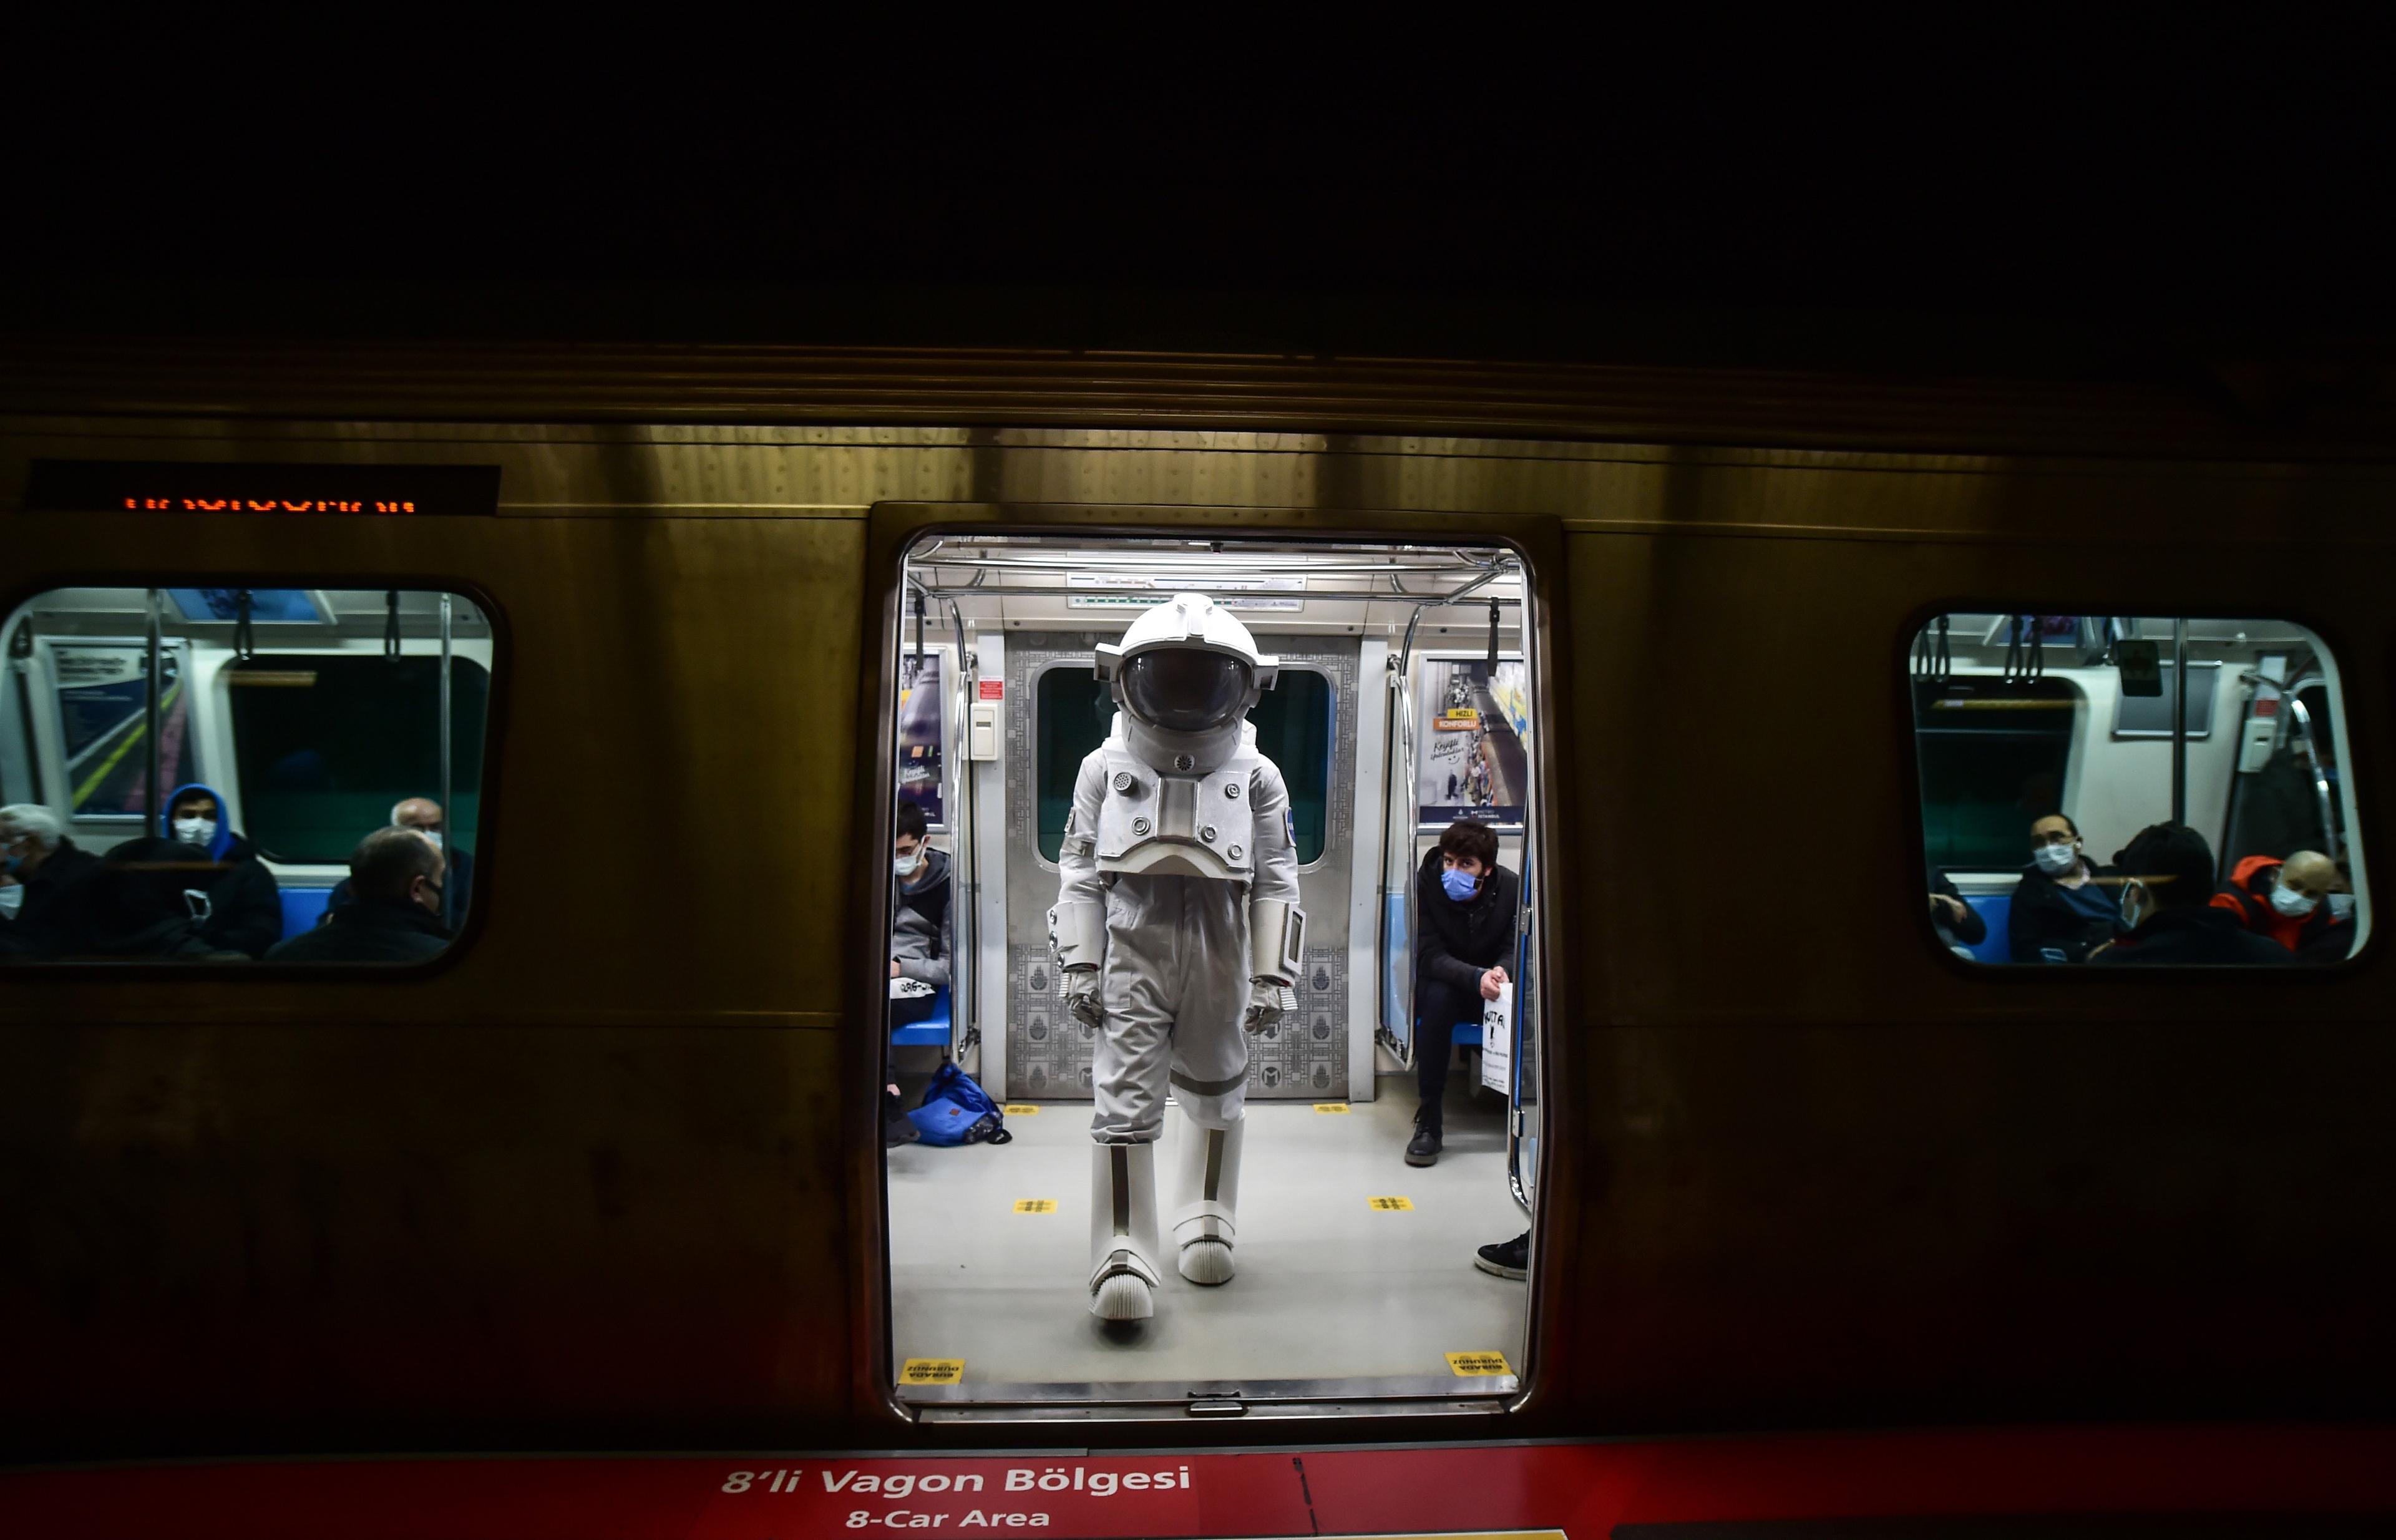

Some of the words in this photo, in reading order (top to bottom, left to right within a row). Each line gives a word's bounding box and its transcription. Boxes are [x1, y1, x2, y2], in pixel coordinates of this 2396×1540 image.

[1439, 720, 1477, 728] KONFORLU
[822, 1470, 984, 1499] Vagon
[1004, 1466, 1191, 1497] Bölgesi
[845, 1510, 950, 1528] 8-Car
[957, 1509, 1049, 1528] Area
